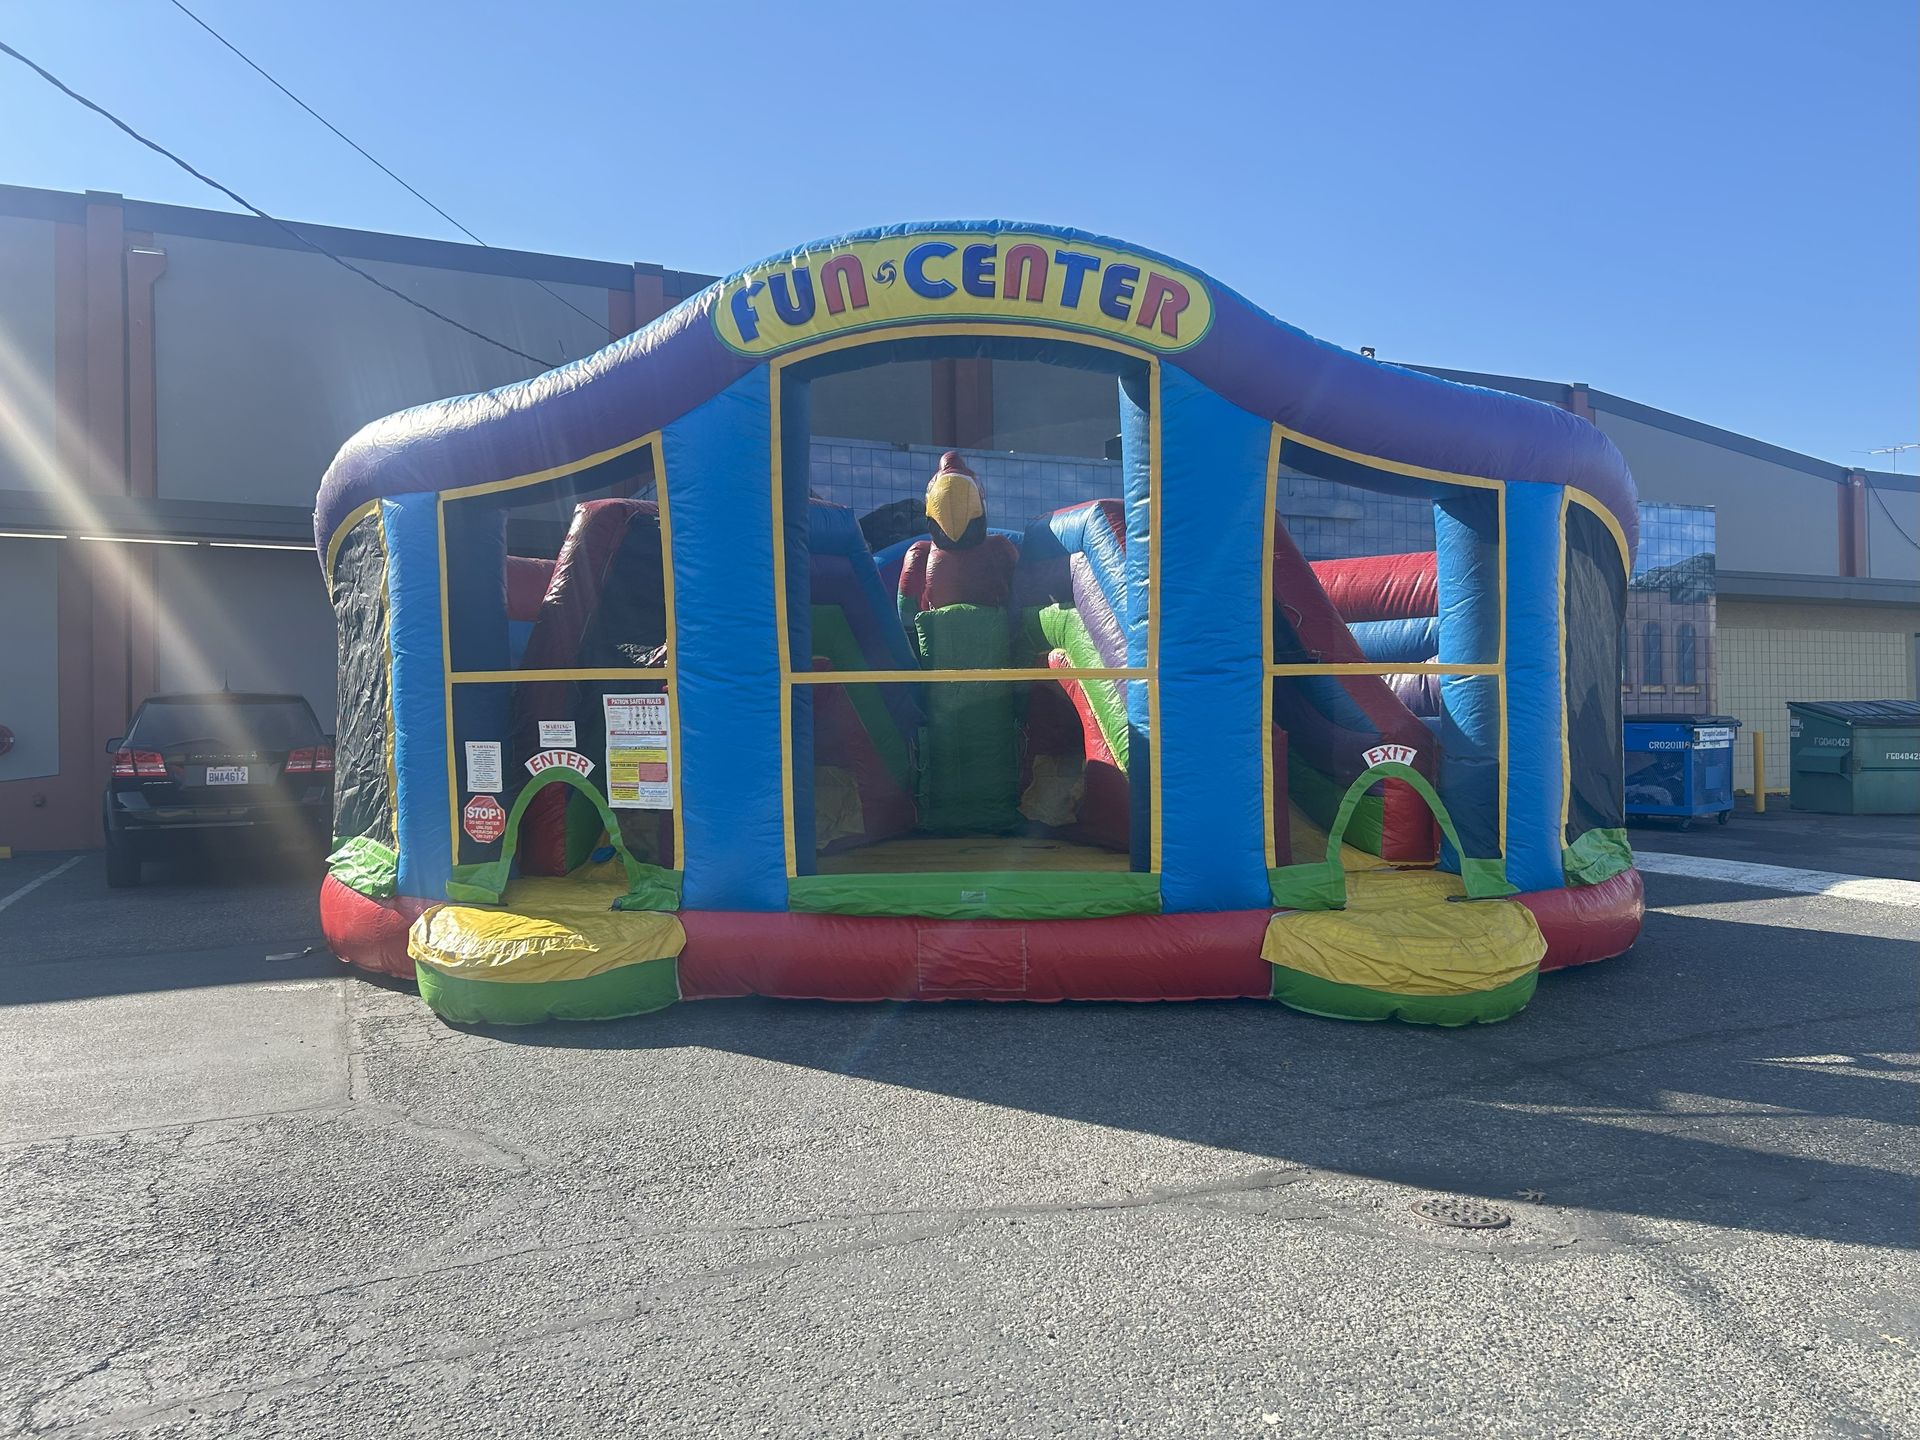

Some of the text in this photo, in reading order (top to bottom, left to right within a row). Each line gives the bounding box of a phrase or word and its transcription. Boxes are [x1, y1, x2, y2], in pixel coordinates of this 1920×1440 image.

[730, 241, 1191, 344] FUN CENTER
[529, 752, 589, 773] ENTER
[1368, 747, 1412, 764] EXIT
[1886, 752, 1920, 760] FG04042
[467, 807, 502, 820] STOP!
